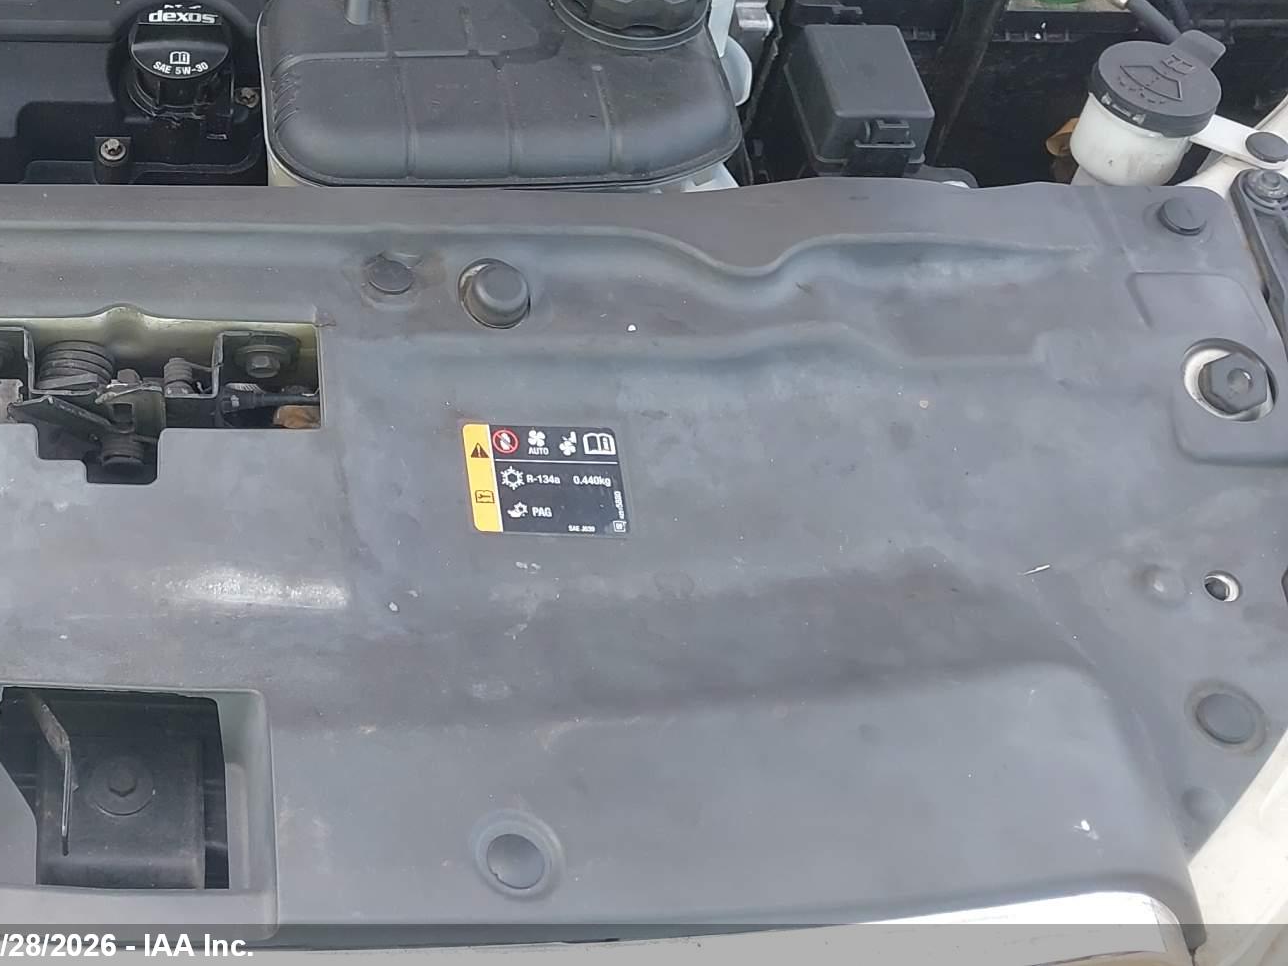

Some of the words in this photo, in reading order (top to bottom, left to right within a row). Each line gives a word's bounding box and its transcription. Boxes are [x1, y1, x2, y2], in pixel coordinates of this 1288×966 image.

[148, 10, 219, 24] dexos
[153, 61, 172, 74] SAE
[175, 62, 209, 75] 5W-30
[528, 447, 549, 455] AUTO
[526, 474, 561, 484] R-134a
[573, 475, 611, 487] 0.440kg
[532, 507, 552, 517] PAG
